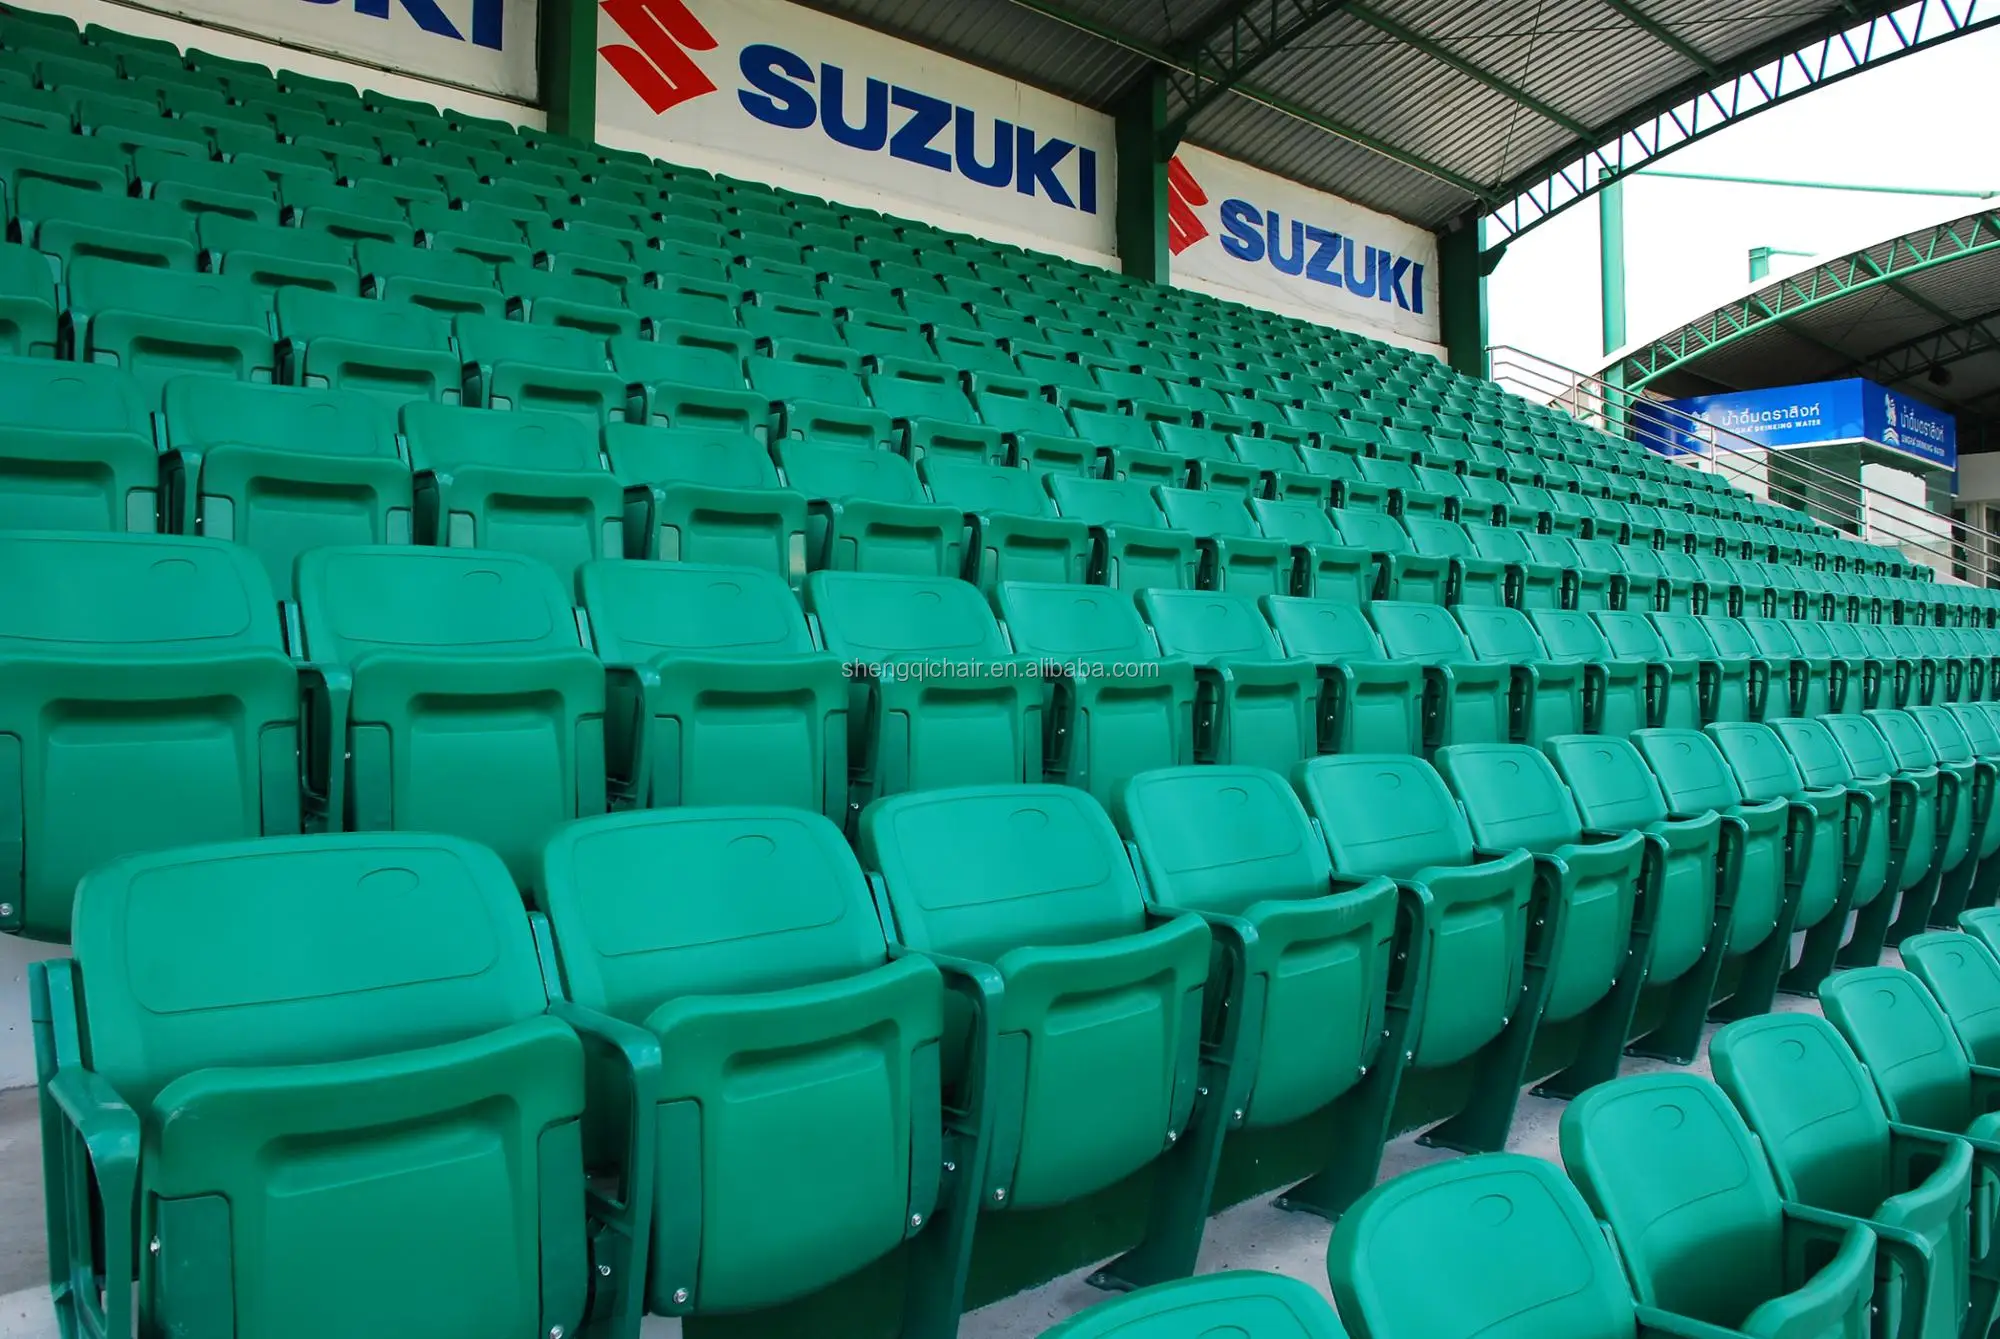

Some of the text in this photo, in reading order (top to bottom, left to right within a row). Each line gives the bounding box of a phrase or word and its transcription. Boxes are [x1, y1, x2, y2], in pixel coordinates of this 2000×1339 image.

[738, 43, 1097, 214] SUZUKI
[1219, 198, 1424, 315] SUZUKI
[1754, 421, 1792, 433] DRINKING
[1795, 419, 1821, 427] WATER
